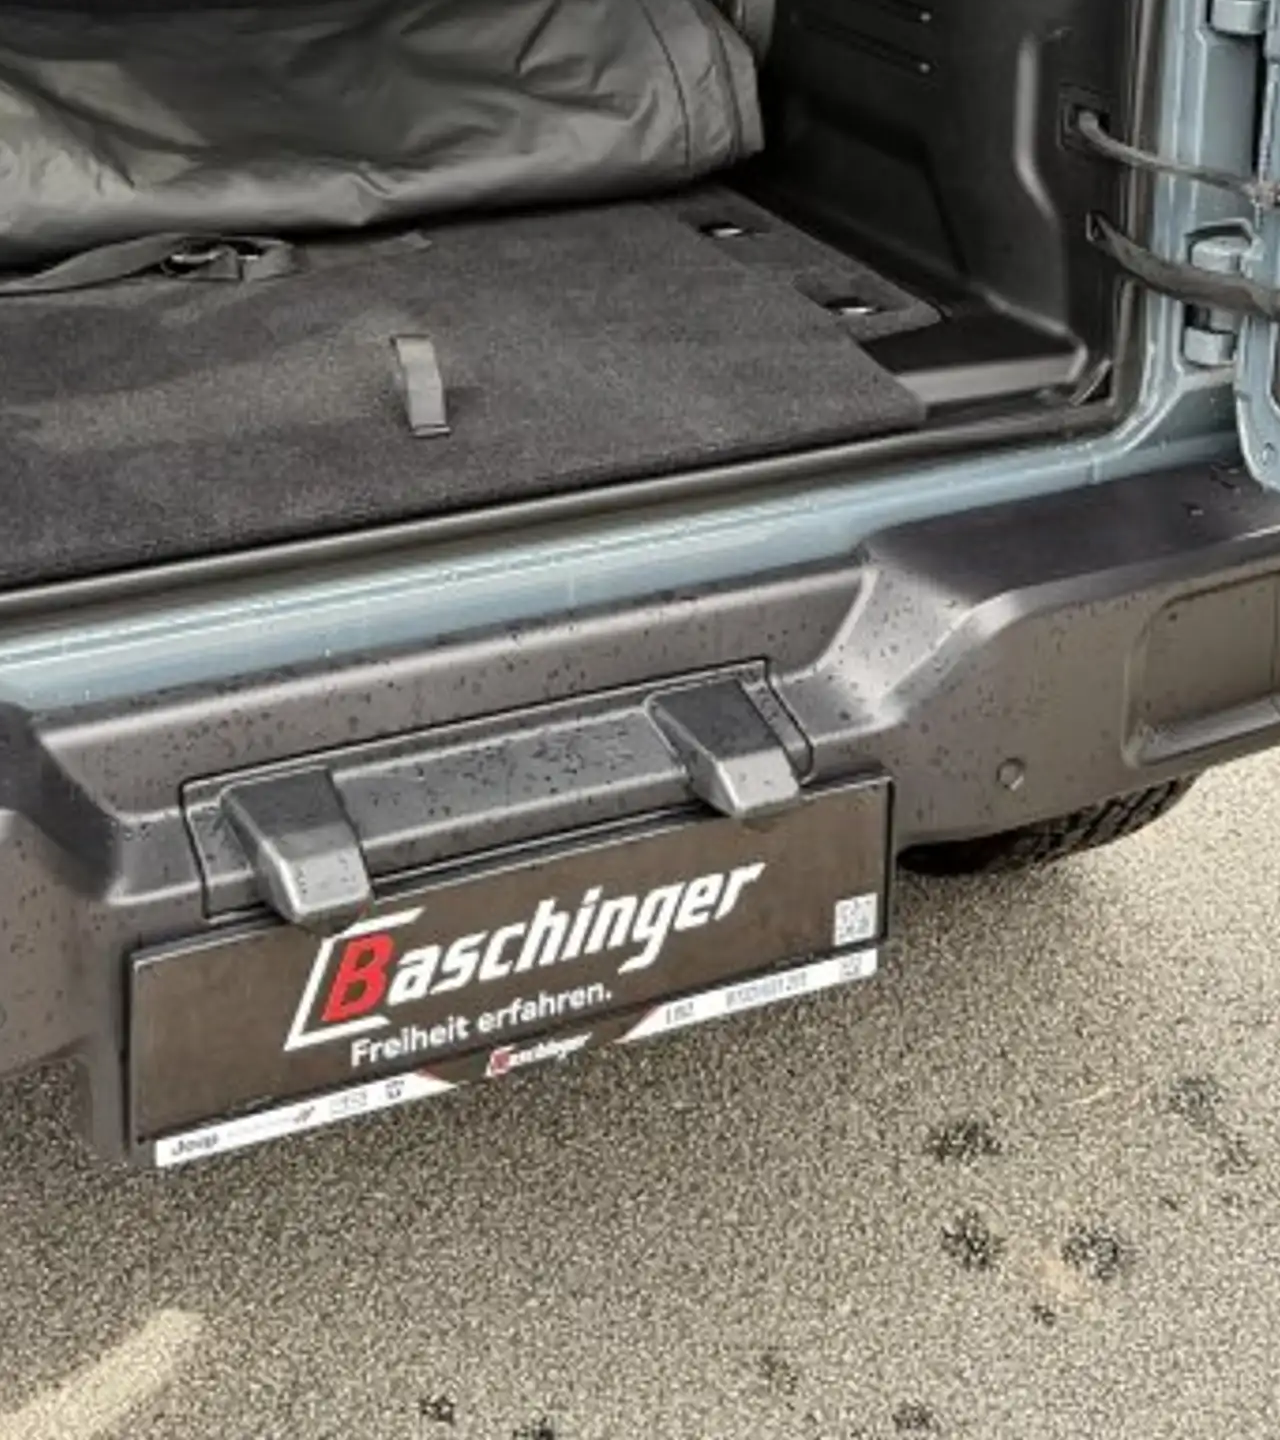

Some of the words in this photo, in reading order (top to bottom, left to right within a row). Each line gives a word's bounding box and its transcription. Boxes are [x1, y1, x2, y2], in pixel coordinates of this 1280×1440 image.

[320, 862, 768, 1023] Baschinger
[350, 1014, 471, 1068] Freiheit
[477, 982, 613, 1033] erfahren.
